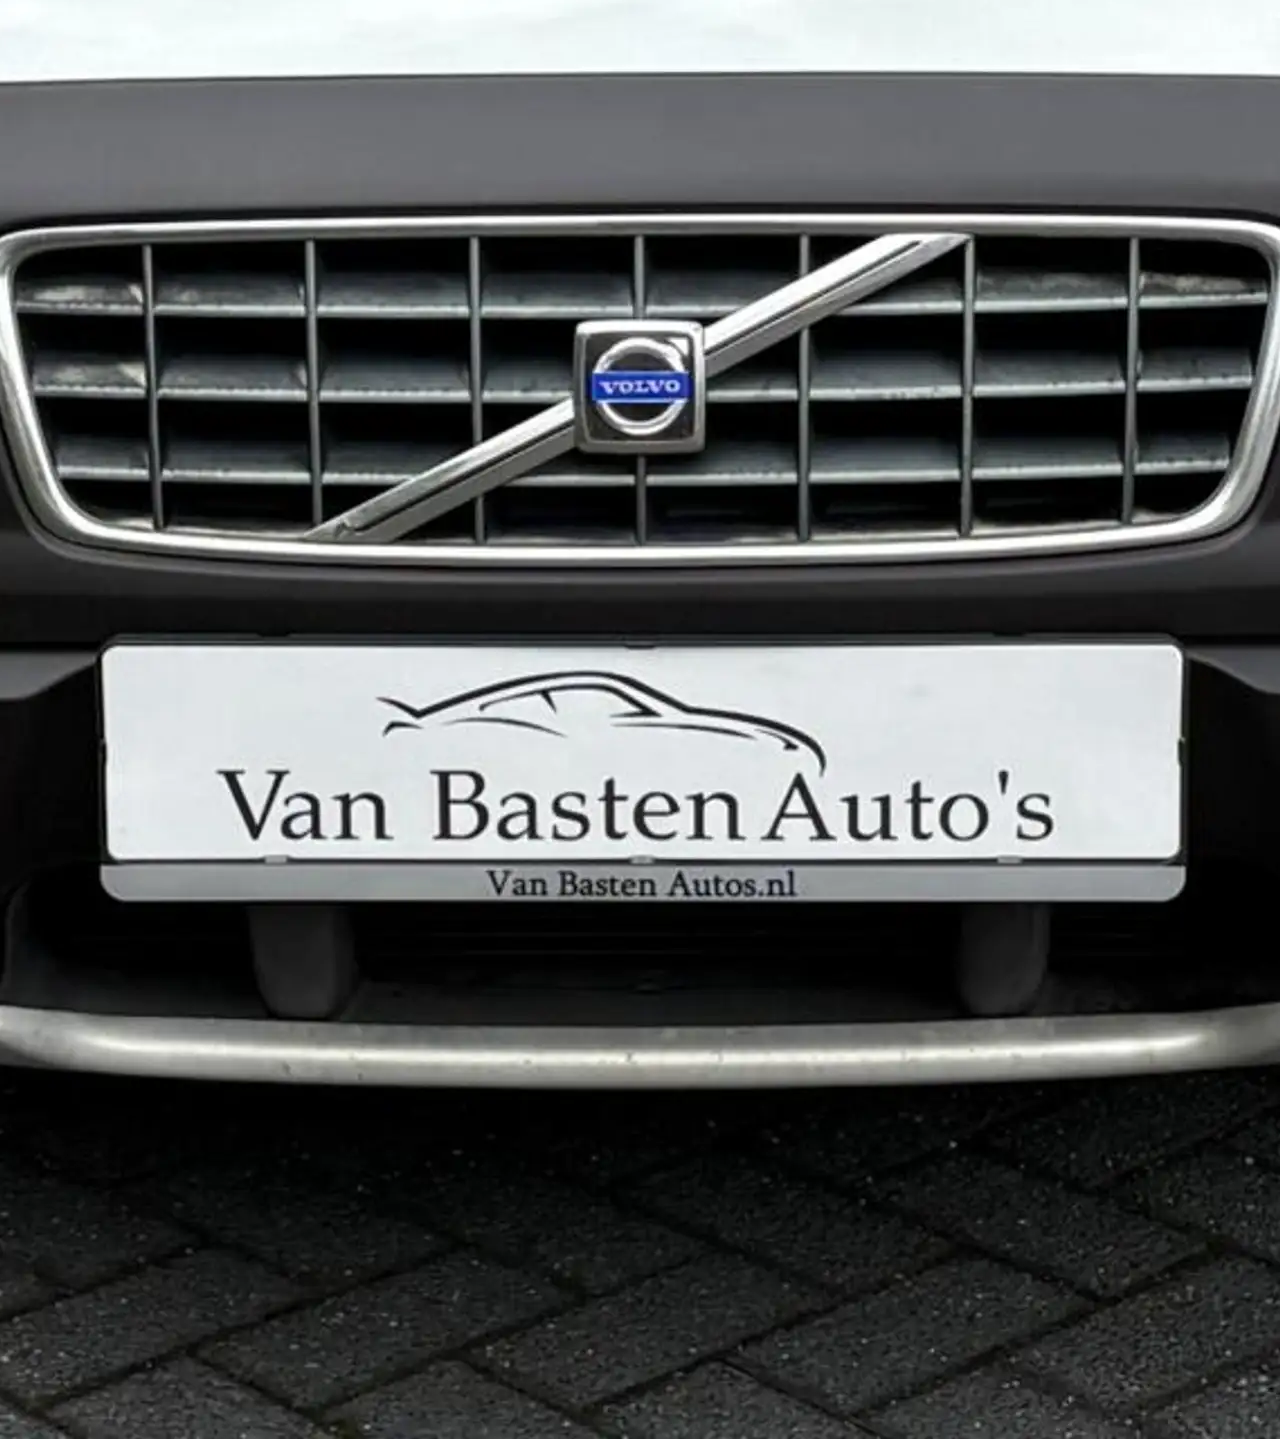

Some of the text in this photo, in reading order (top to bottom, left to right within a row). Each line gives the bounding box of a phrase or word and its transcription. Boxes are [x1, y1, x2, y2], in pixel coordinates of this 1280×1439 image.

[599, 379, 681, 395] VOLVO
[217, 769, 1055, 841] Van Basten Auto's
[486, 869, 797, 897] Van Basten Autos.nl
